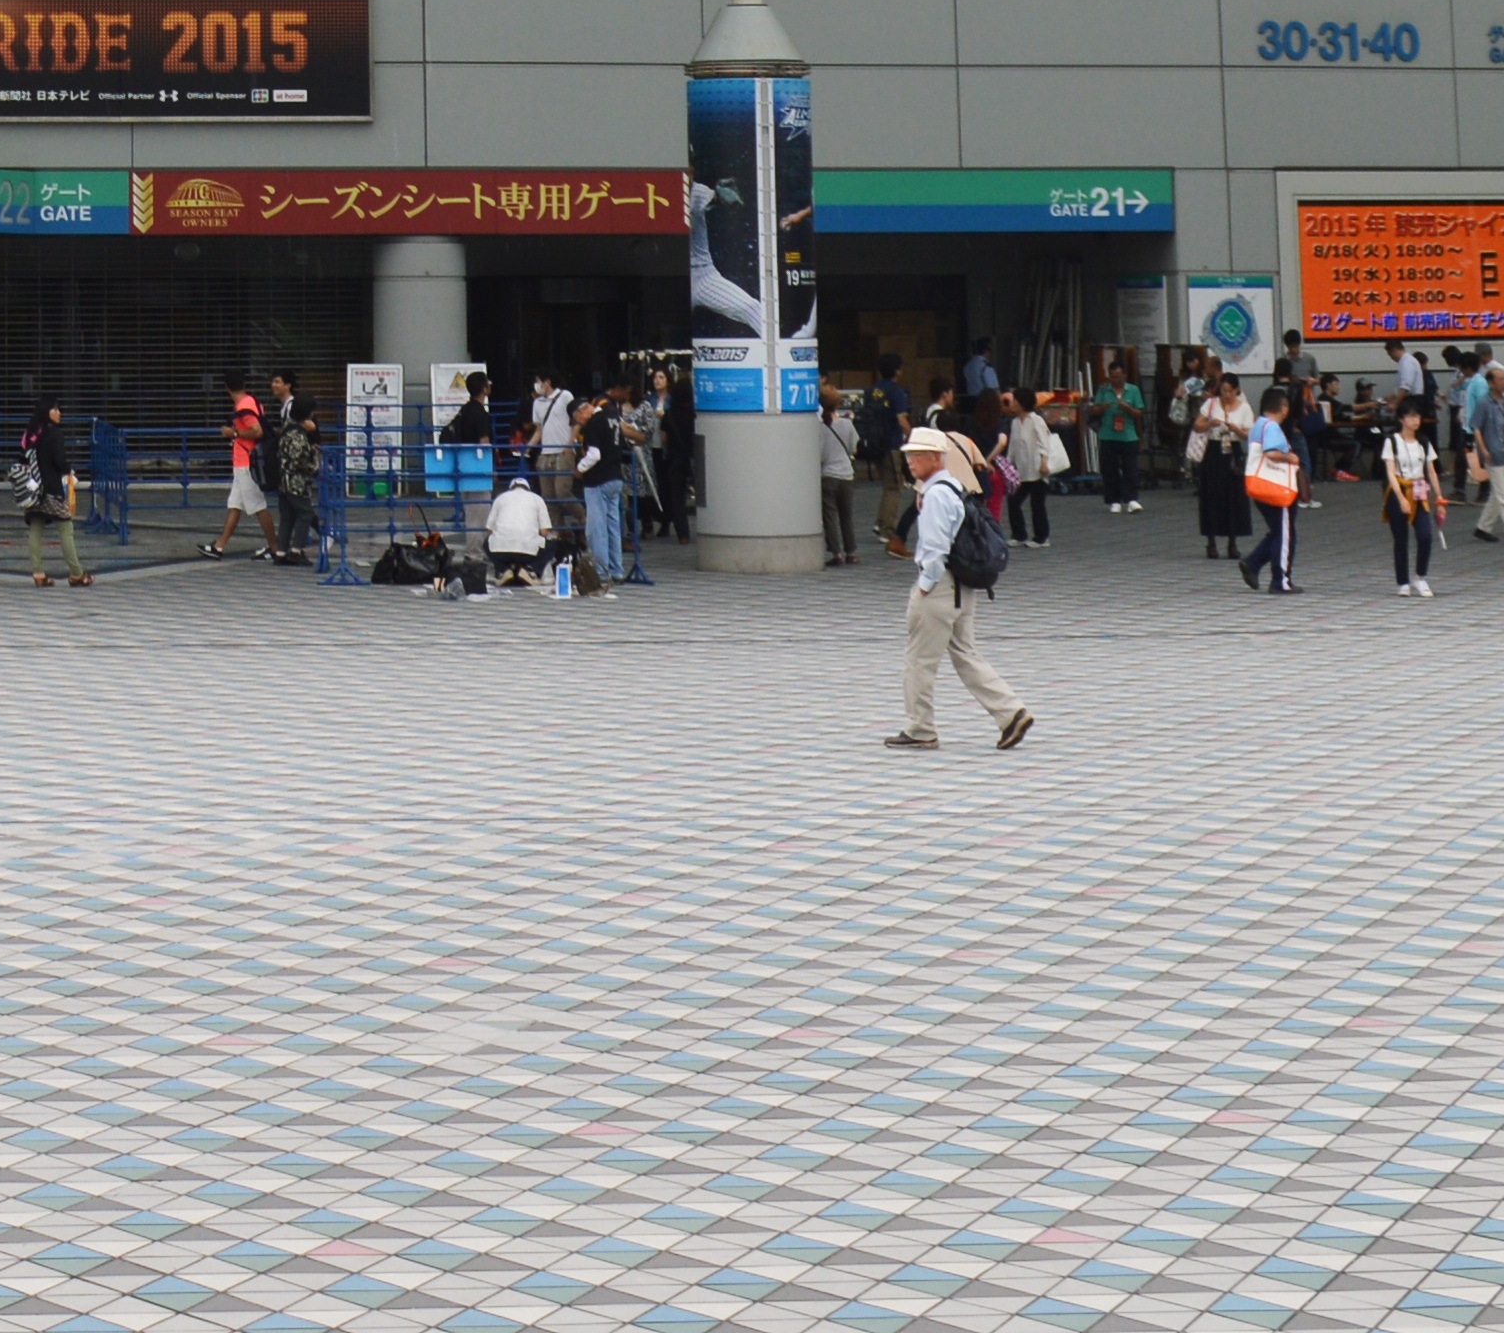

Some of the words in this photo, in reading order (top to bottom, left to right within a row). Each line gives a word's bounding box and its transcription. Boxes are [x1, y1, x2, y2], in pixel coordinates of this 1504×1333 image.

[161, 10, 309, 73] 2015
[36, 89, 91, 102] 日本テレビ
[98, 91, 126, 100] Official
[186, 91, 214, 100] Official
[41, 183, 91, 202] ゲート
[1049, 188, 1088, 203] ゲート
[260, 181, 670, 221] シーズンシート専用ゲート
[1091, 187, 1125, 217] 21
[40, 205, 92, 222] GATE
[170, 208, 214, 219] SEASON
[218, 208, 240, 219] SEAT
[1050, 204, 1088, 217] GATE
[182, 218, 228, 228] OWNERS
[785, 269, 800, 287] 19
